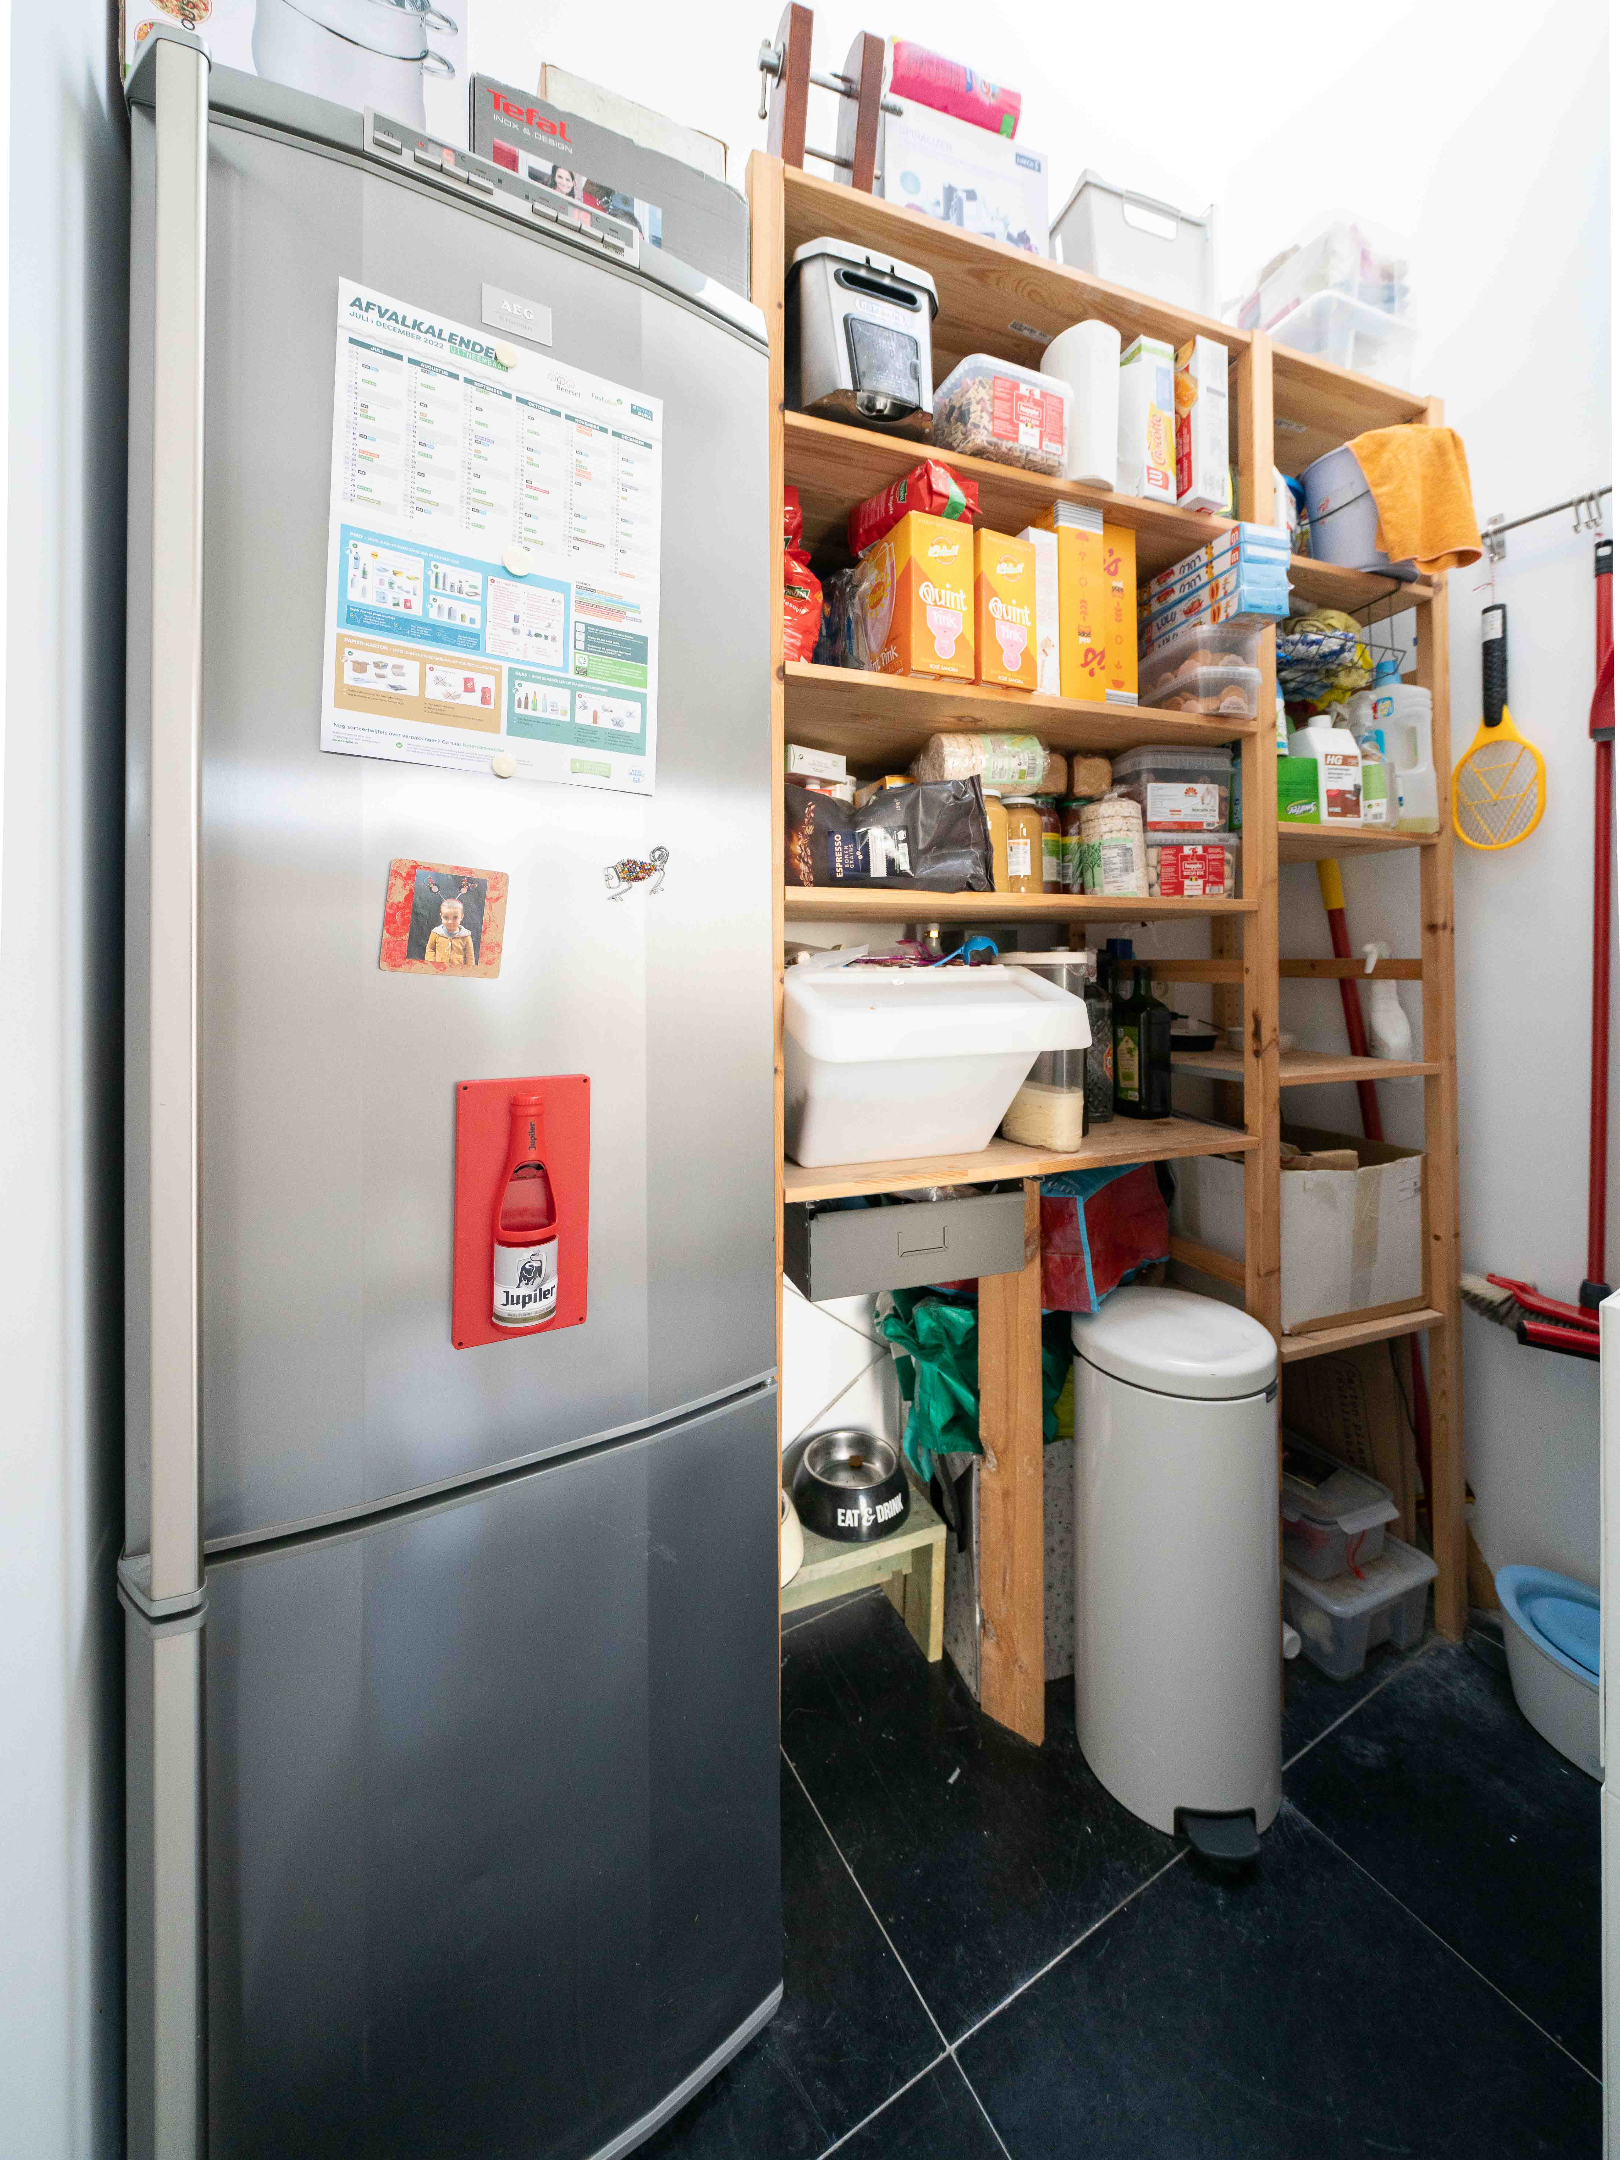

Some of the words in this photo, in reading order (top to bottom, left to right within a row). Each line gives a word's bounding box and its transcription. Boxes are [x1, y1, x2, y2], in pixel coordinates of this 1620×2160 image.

[486, 88, 572, 144] Tefal
[493, 113, 519, 131] INOX
[523, 127, 530, 136] &
[534, 132, 573, 154] DESIGN
[500, 300, 534, 320] AEG
[349, 297, 498, 360] AFVALKALENDE
[349, 312, 369, 323] JULI
[375, 320, 422, 342] DECEMBER
[423, 337, 444, 349] 2022
[556, 385, 581, 398] Beersel
[1148, 467, 1163, 486] LU
[919, 581, 968, 611] Quint
[931, 610, 958, 628] Pink
[988, 597, 1031, 626] Quint
[1156, 611, 1177, 631] LULU
[1000, 626, 1022, 644] Pink
[1326, 755, 1343, 765] HG
[1286, 801, 1316, 815] Swiffer
[834, 834, 844, 878] ESPRESSO
[528, 1121, 537, 1151] Jupiler
[500, 1284, 556, 1310] Jupiler
[837, 1508, 860, 1527] EAT
[861, 1507, 876, 1527] &
[876, 1493, 905, 1523] DRINK
